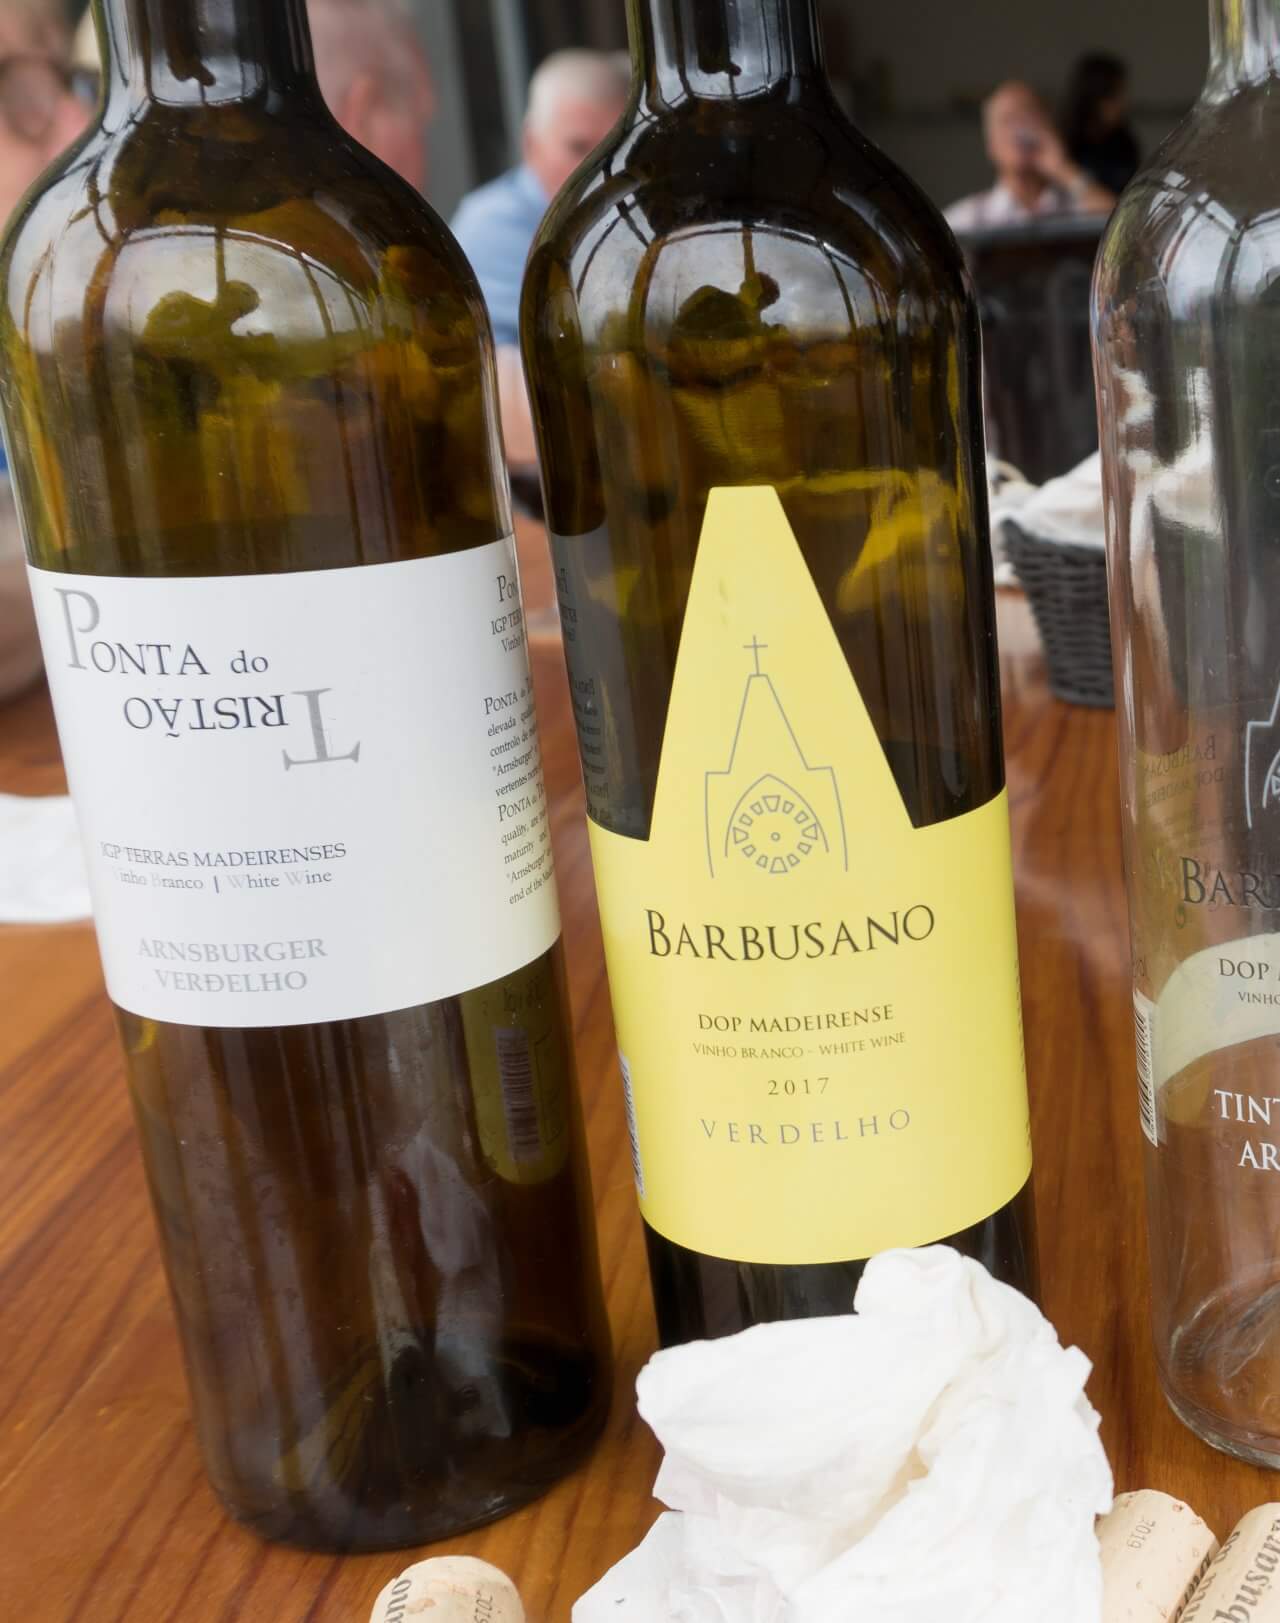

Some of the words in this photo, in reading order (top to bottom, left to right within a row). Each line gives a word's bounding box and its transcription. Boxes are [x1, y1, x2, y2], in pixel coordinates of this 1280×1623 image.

[53, 586, 210, 675] PONTA
[230, 650, 269, 674] do
[125, 847, 190, 867] TERRAS
[193, 843, 347, 867] MADEIRENSES
[151, 870, 204, 890] Branco
[227, 874, 280, 889] White
[284, 870, 332, 885] Wine
[645, 904, 935, 961] BARBUSANO
[138, 937, 328, 963] ARNSBURGER
[1219, 958, 1270, 980] DOP
[698, 1013, 742, 1032] DOP
[749, 1004, 894, 1033] MADEIRENSE
[692, 1042, 737, 1058] VINHO
[741, 1046, 804, 1059] BRANCO
[819, 1039, 866, 1056] WHITE
[870, 1032, 906, 1049] WINE
[767, 1077, 829, 1096] 2017
[700, 1108, 911, 1145] VERDELHO
